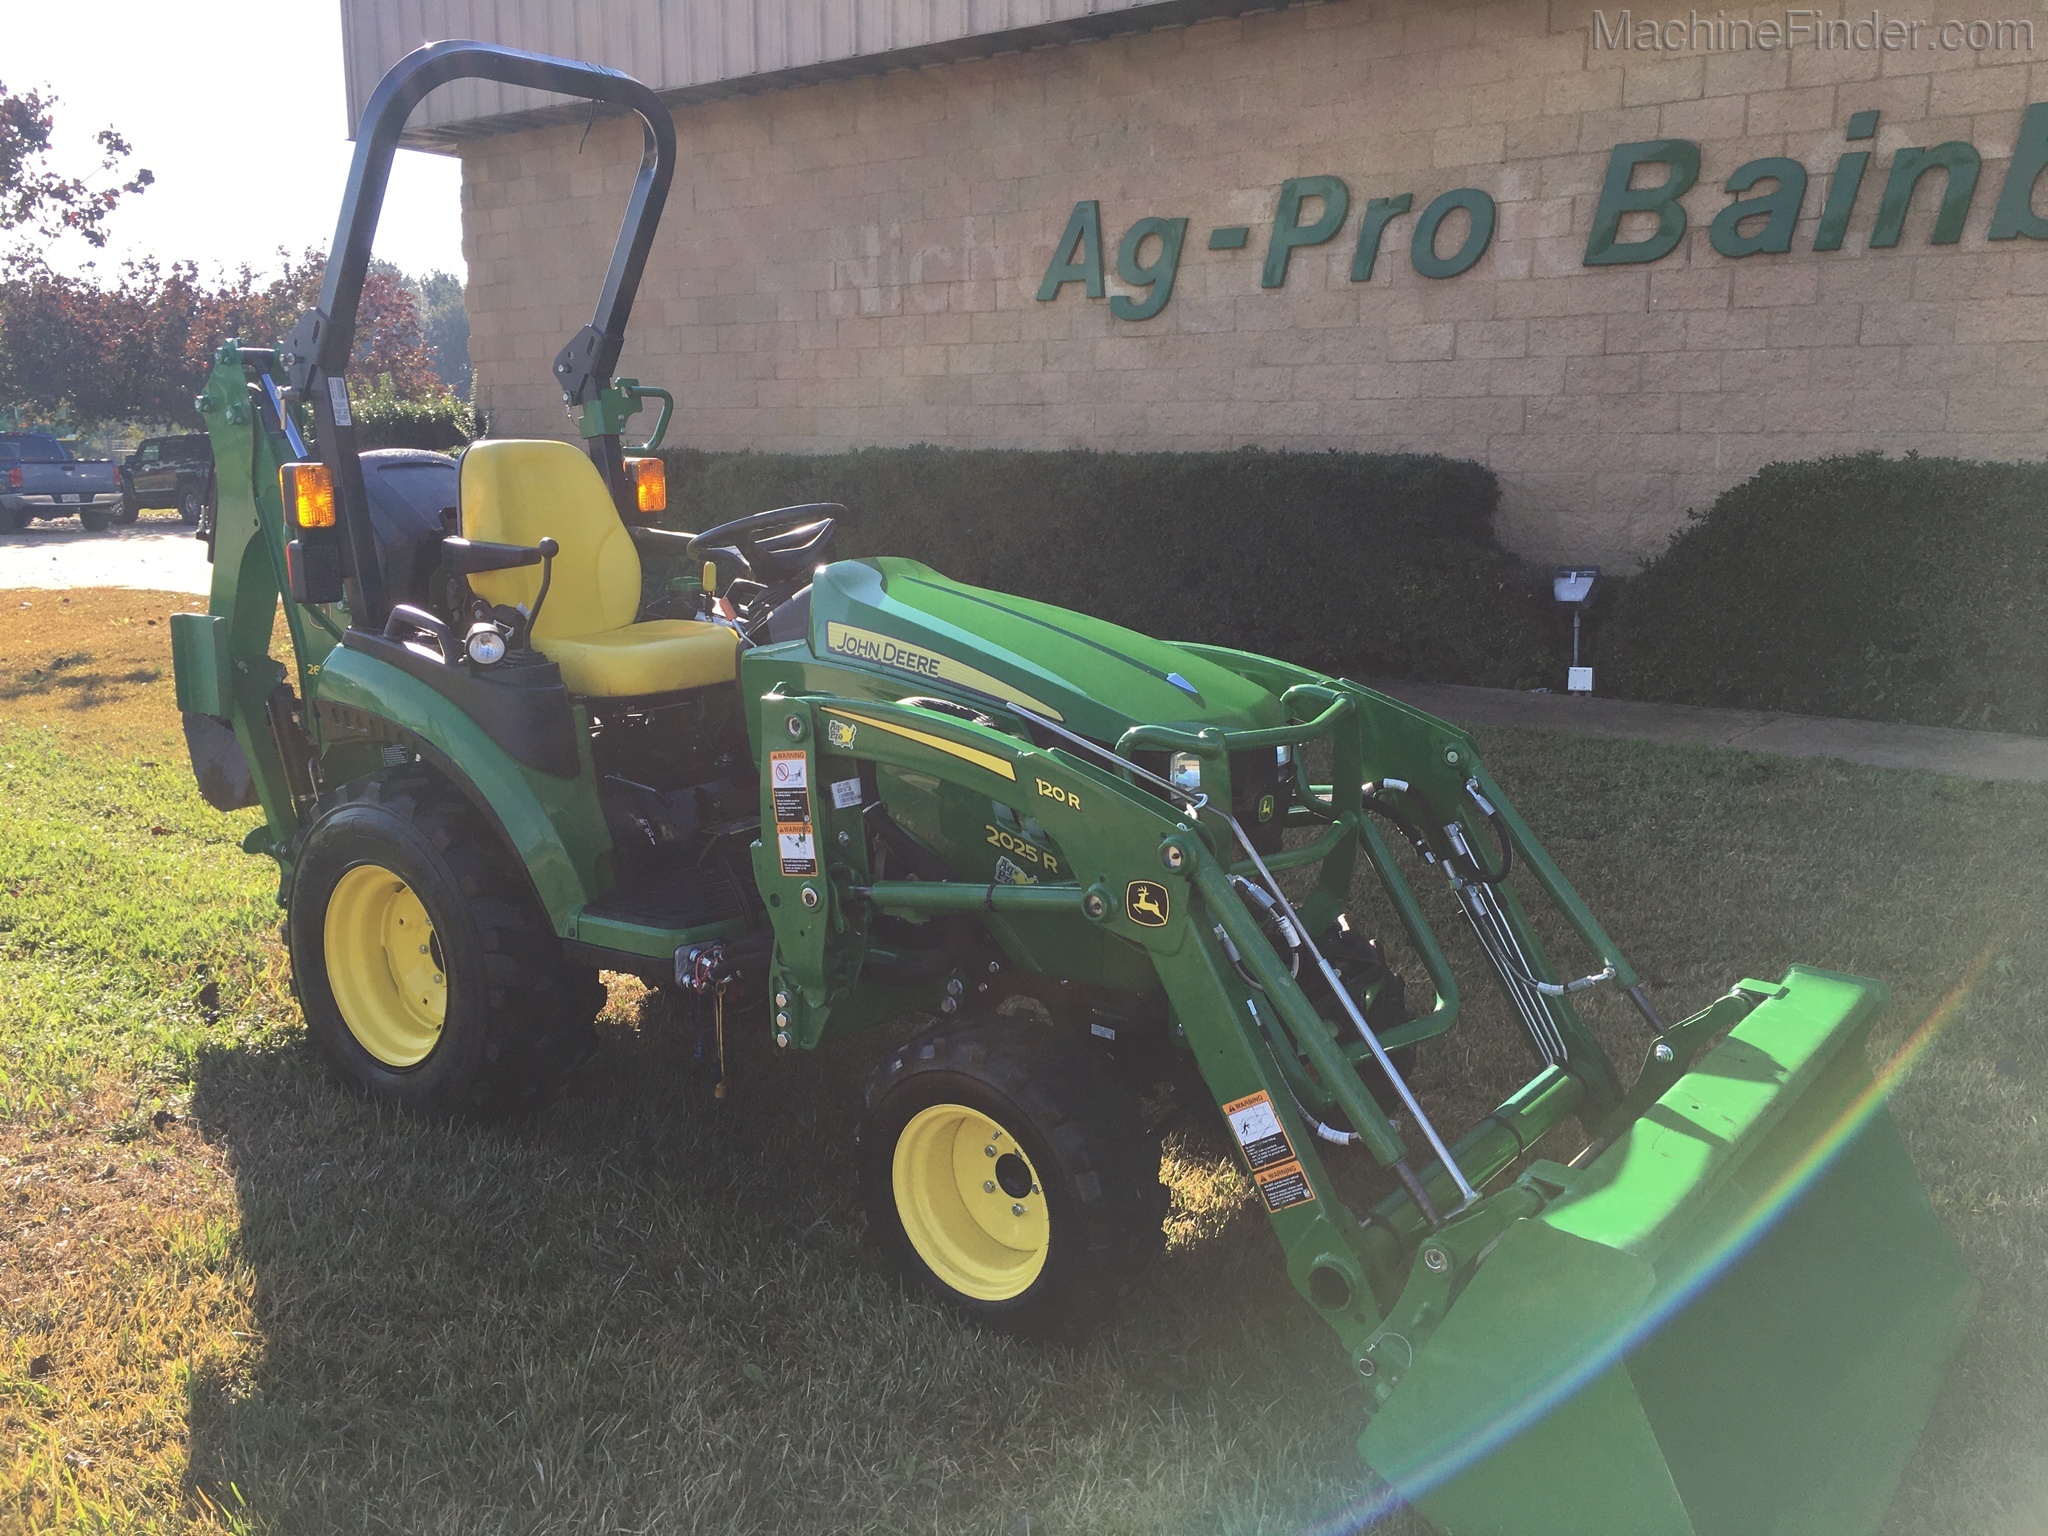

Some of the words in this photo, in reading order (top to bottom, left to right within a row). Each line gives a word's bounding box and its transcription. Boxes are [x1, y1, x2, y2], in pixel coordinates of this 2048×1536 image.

[882, 642, 940, 676] DEERE
[777, 751, 804, 759] WARNING
[1035, 777, 1065, 802] 120
[1067, 791, 1081, 810] R
[985, 824, 1038, 863] 2025
[1043, 852, 1058, 874] R
[1235, 1095, 1264, 1109] WARNING
[1267, 1166, 1297, 1179] WARNING
